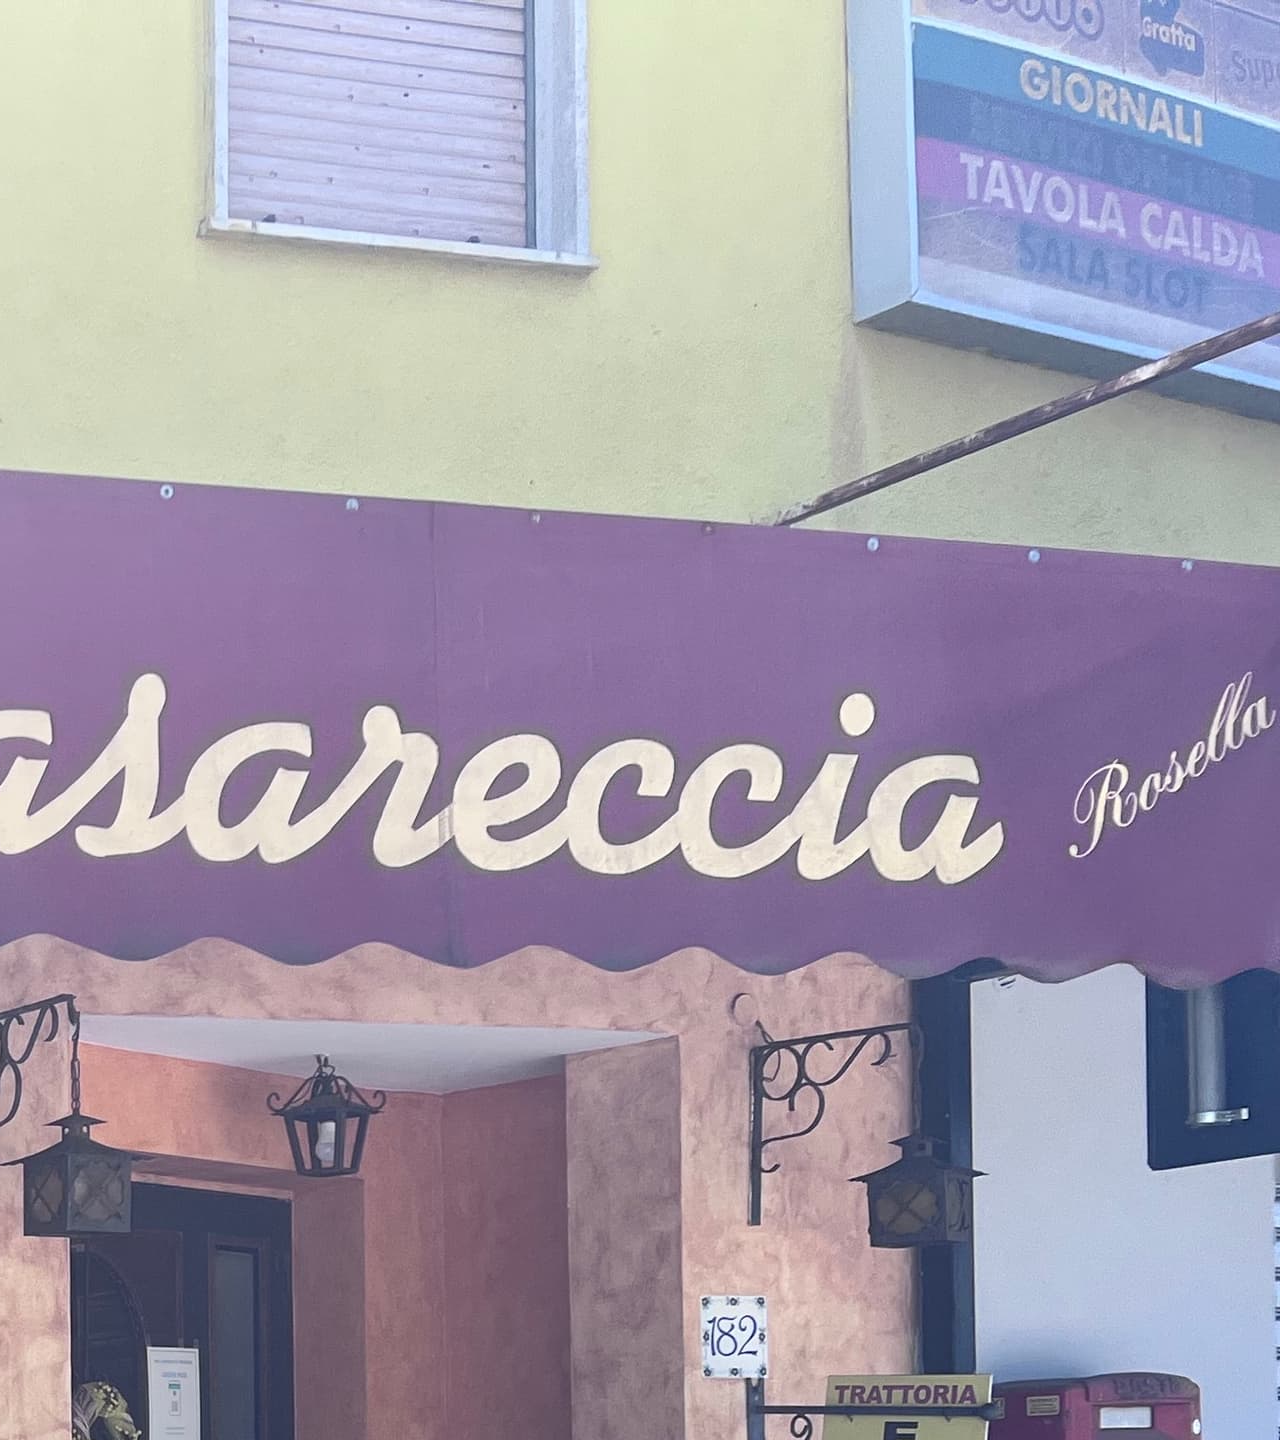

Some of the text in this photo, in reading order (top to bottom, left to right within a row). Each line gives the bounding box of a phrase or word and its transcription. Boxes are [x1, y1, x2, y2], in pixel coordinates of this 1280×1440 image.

[1142, 16, 1196, 51] Gratta
[1019, 58, 1204, 147] GIORNALI
[959, 152, 1127, 239] TAVOLA
[1140, 202, 1265, 278] CALDA
[1017, 235, 1111, 292] SALA
[1069, 671, 1277, 859] Rosella
[705, 1313, 759, 1357] 182
[834, 1384, 977, 1405] TRATTORIA
